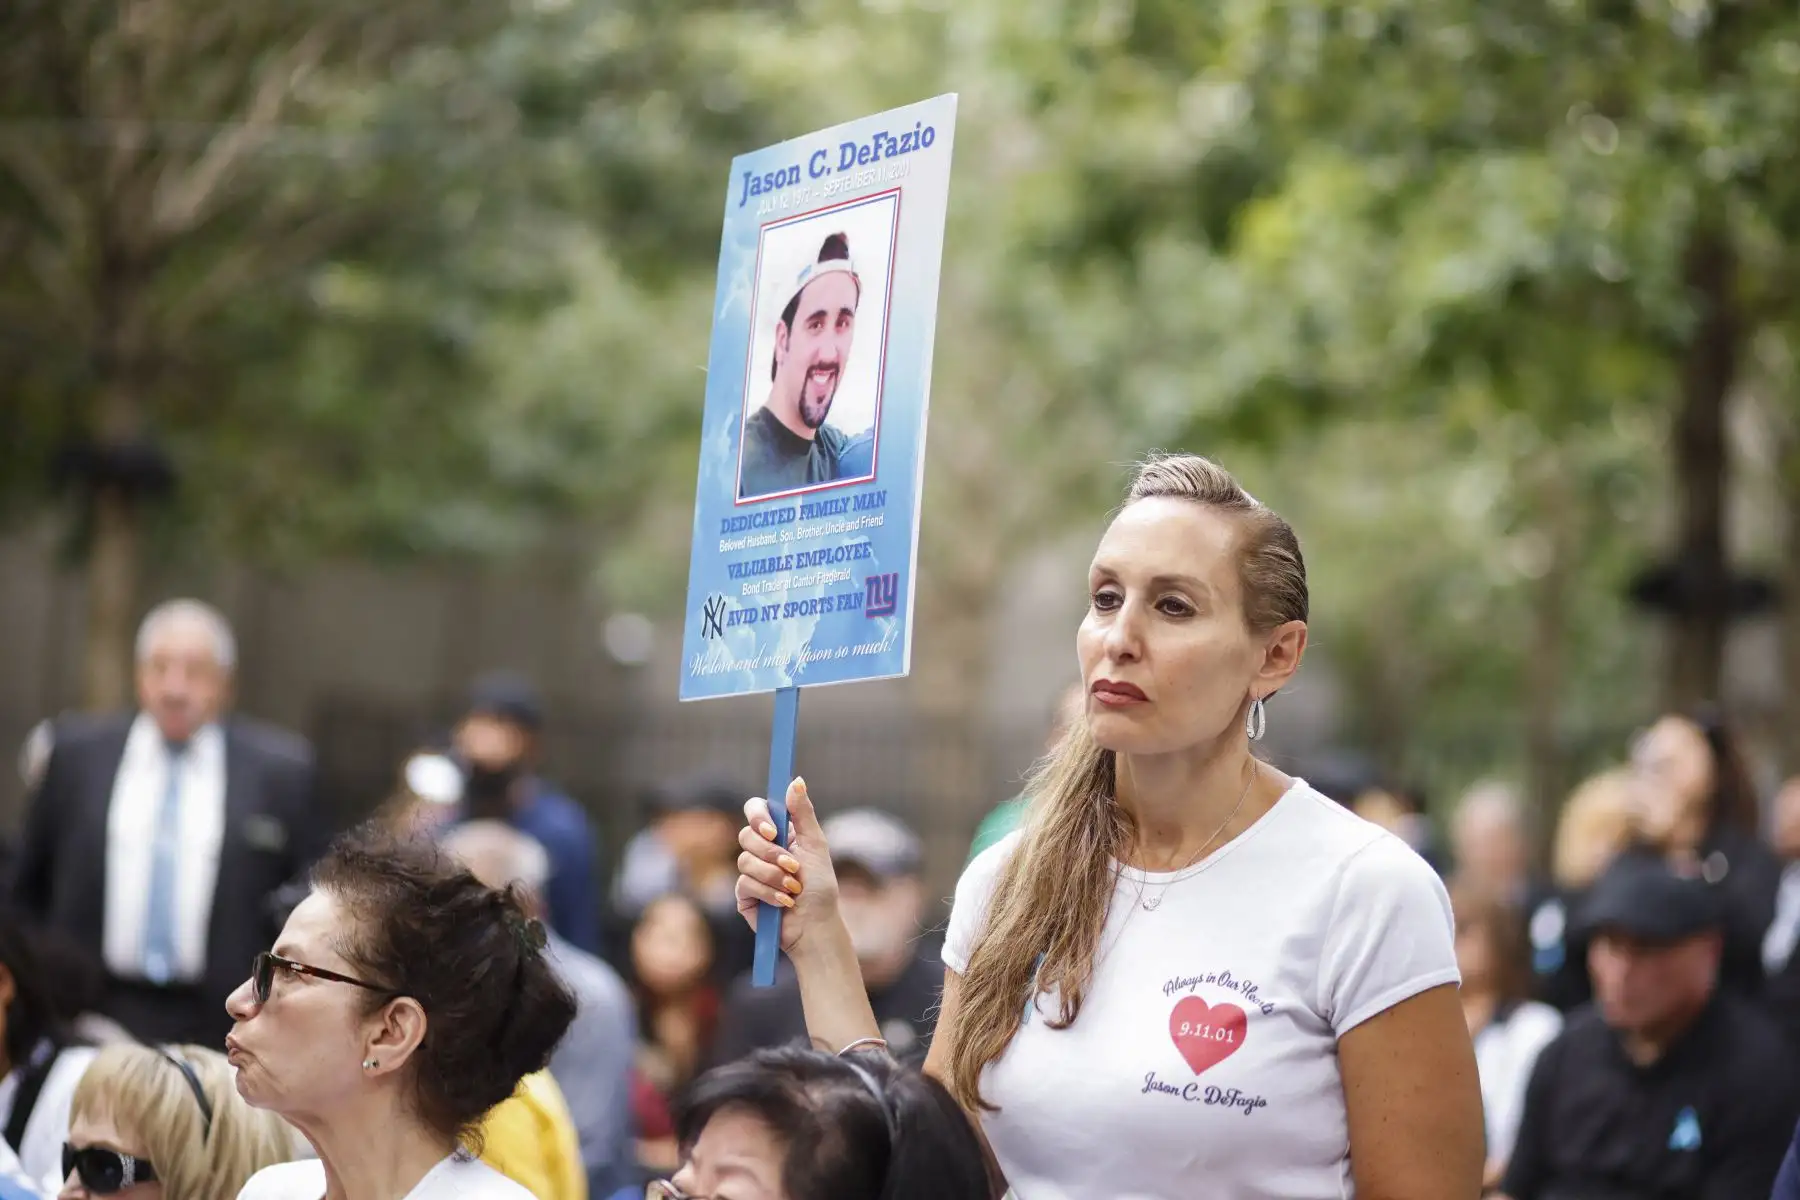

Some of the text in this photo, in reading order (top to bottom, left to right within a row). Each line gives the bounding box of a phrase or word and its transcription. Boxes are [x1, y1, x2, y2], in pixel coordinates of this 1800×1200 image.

[740, 122, 935, 208] Jason C. DeFazio
[720, 490, 887, 535] DEDICATED FAMILY MAN
[720, 537, 747, 552] Beloved
[825, 520, 845, 535] Uncle
[846, 518, 859, 532] and
[861, 514, 884, 529] Friend
[728, 542, 872, 580] VALUABLE EMPLOYEE
[742, 581, 760, 595] Bond
[761, 577, 784, 593] Trader
[793, 573, 815, 589] Cantor
[817, 568, 850, 587] Fitzgerald
[727, 592, 863, 627] AVID NY SPORTS FAN
[689, 624, 899, 679] We love and miss Jason so much!
[1163, 973, 1203, 997] Always
[1206, 973, 1216, 983] in
[1217, 970, 1239, 990] Our
[1178, 1022, 1234, 1043] 9.11.01
[1142, 1071, 1267, 1116] Jason C. DeFazio
